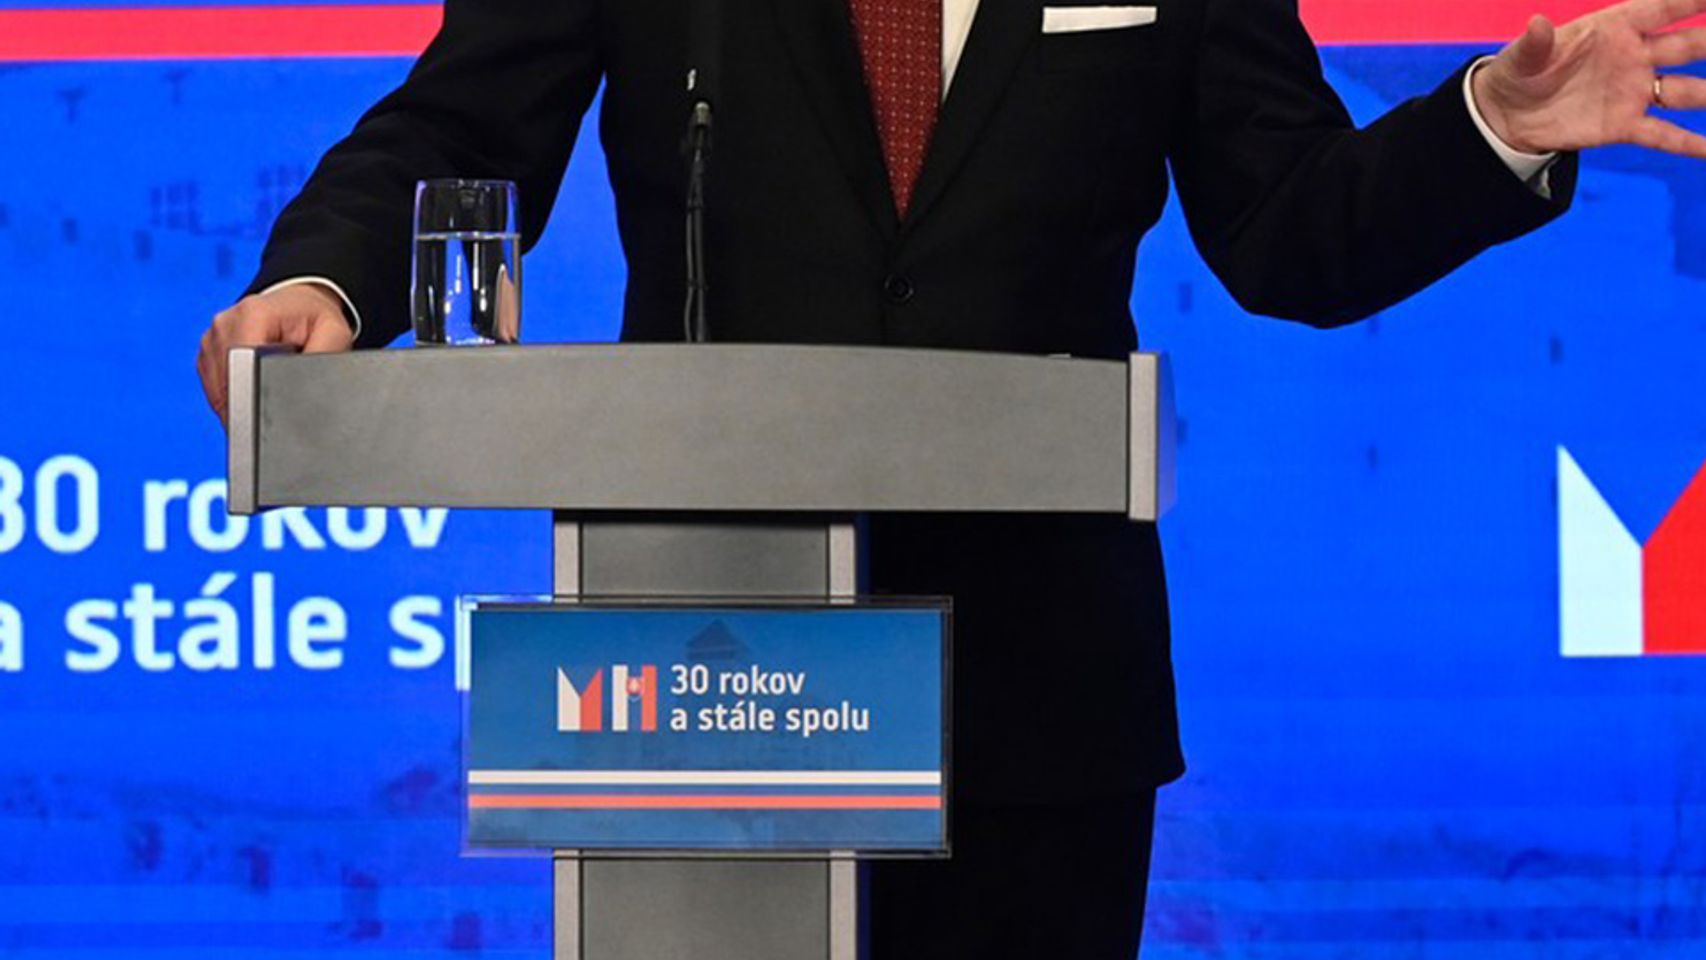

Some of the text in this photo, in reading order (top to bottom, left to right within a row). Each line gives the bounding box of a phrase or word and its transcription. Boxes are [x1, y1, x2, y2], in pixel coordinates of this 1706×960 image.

[65, 572, 347, 671] stále
[671, 664, 805, 695] 30 rokov
[670, 700, 869, 737] a stále spolu
